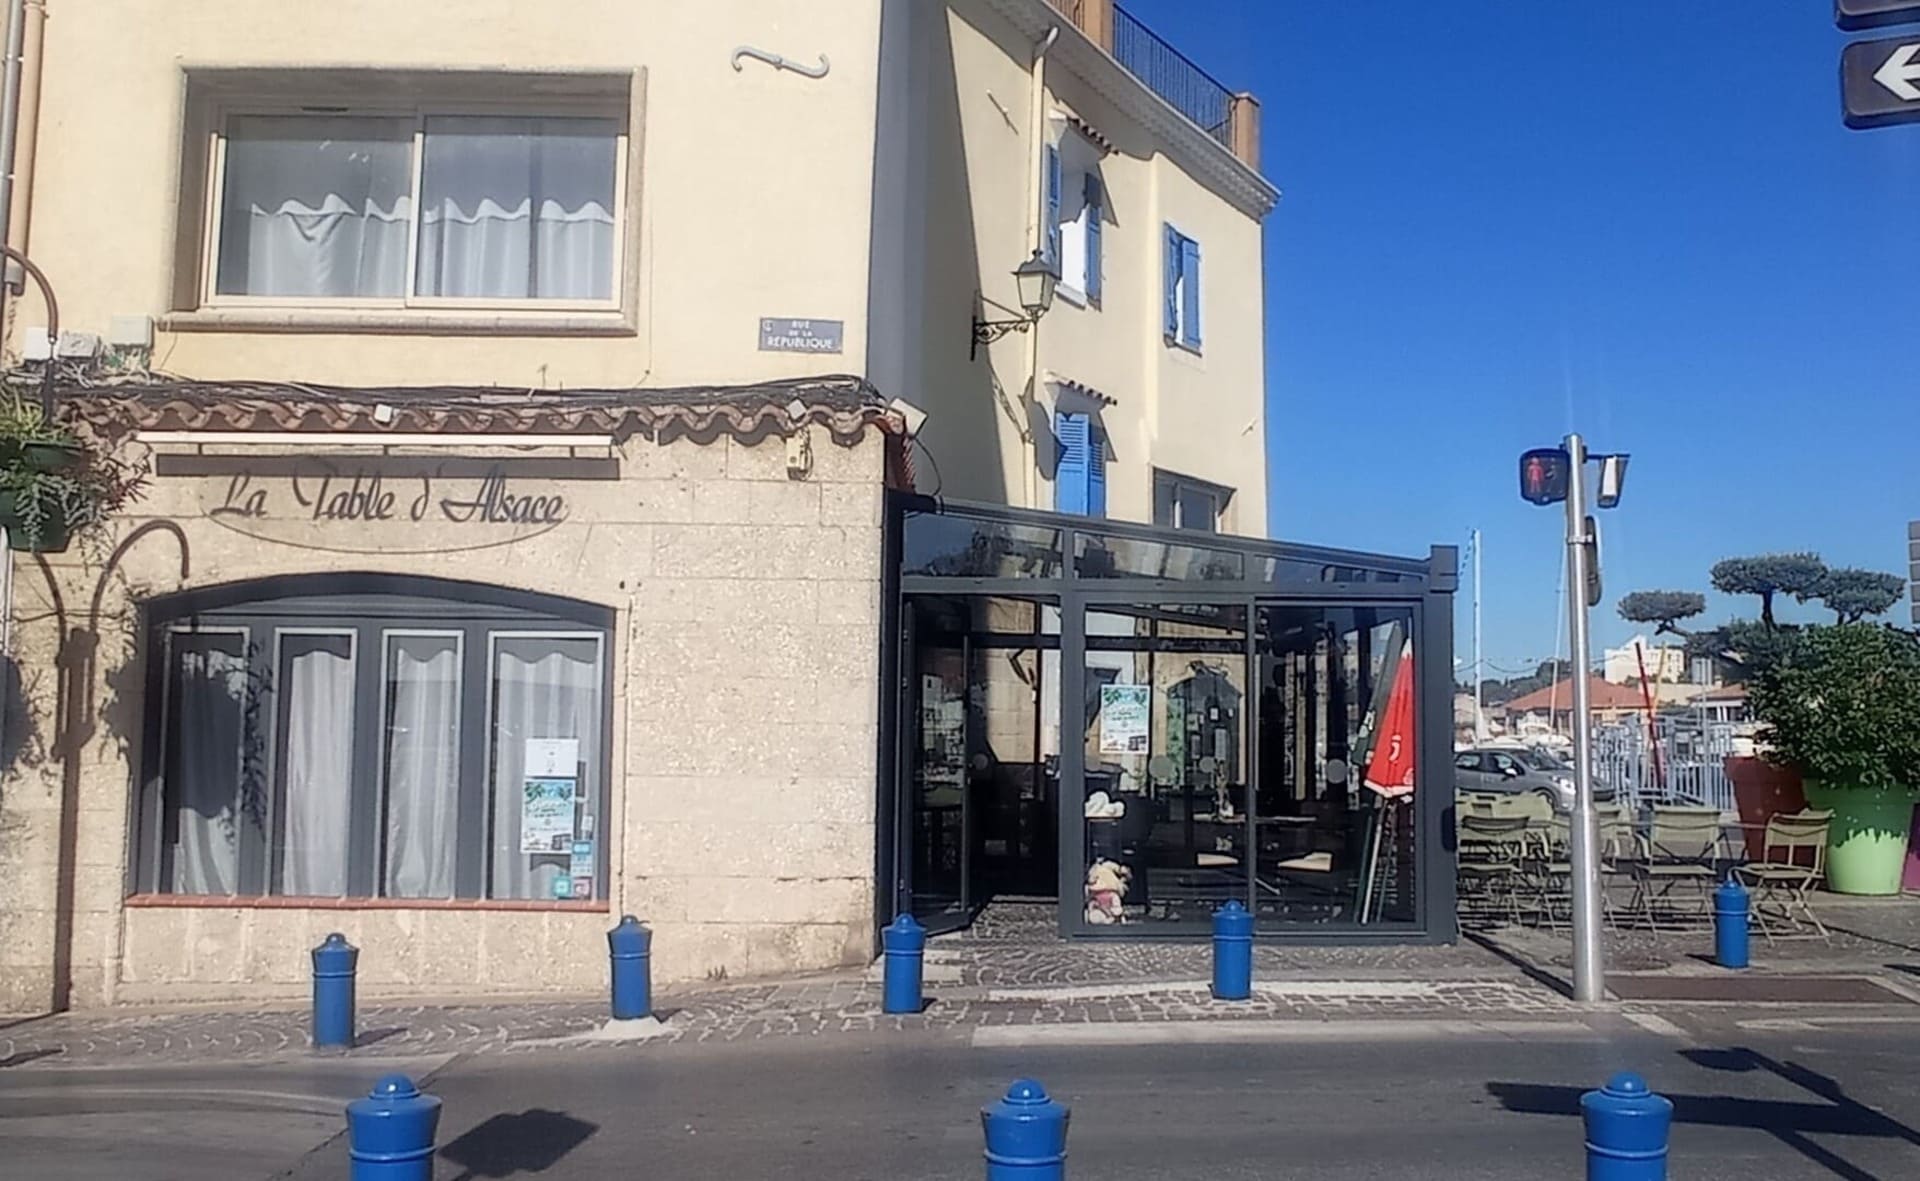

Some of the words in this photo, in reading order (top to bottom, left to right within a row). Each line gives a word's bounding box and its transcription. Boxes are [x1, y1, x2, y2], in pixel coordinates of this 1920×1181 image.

[791, 320, 810, 329] RUE
[210, 468, 269, 518] La
[292, 455, 396, 521] Table
